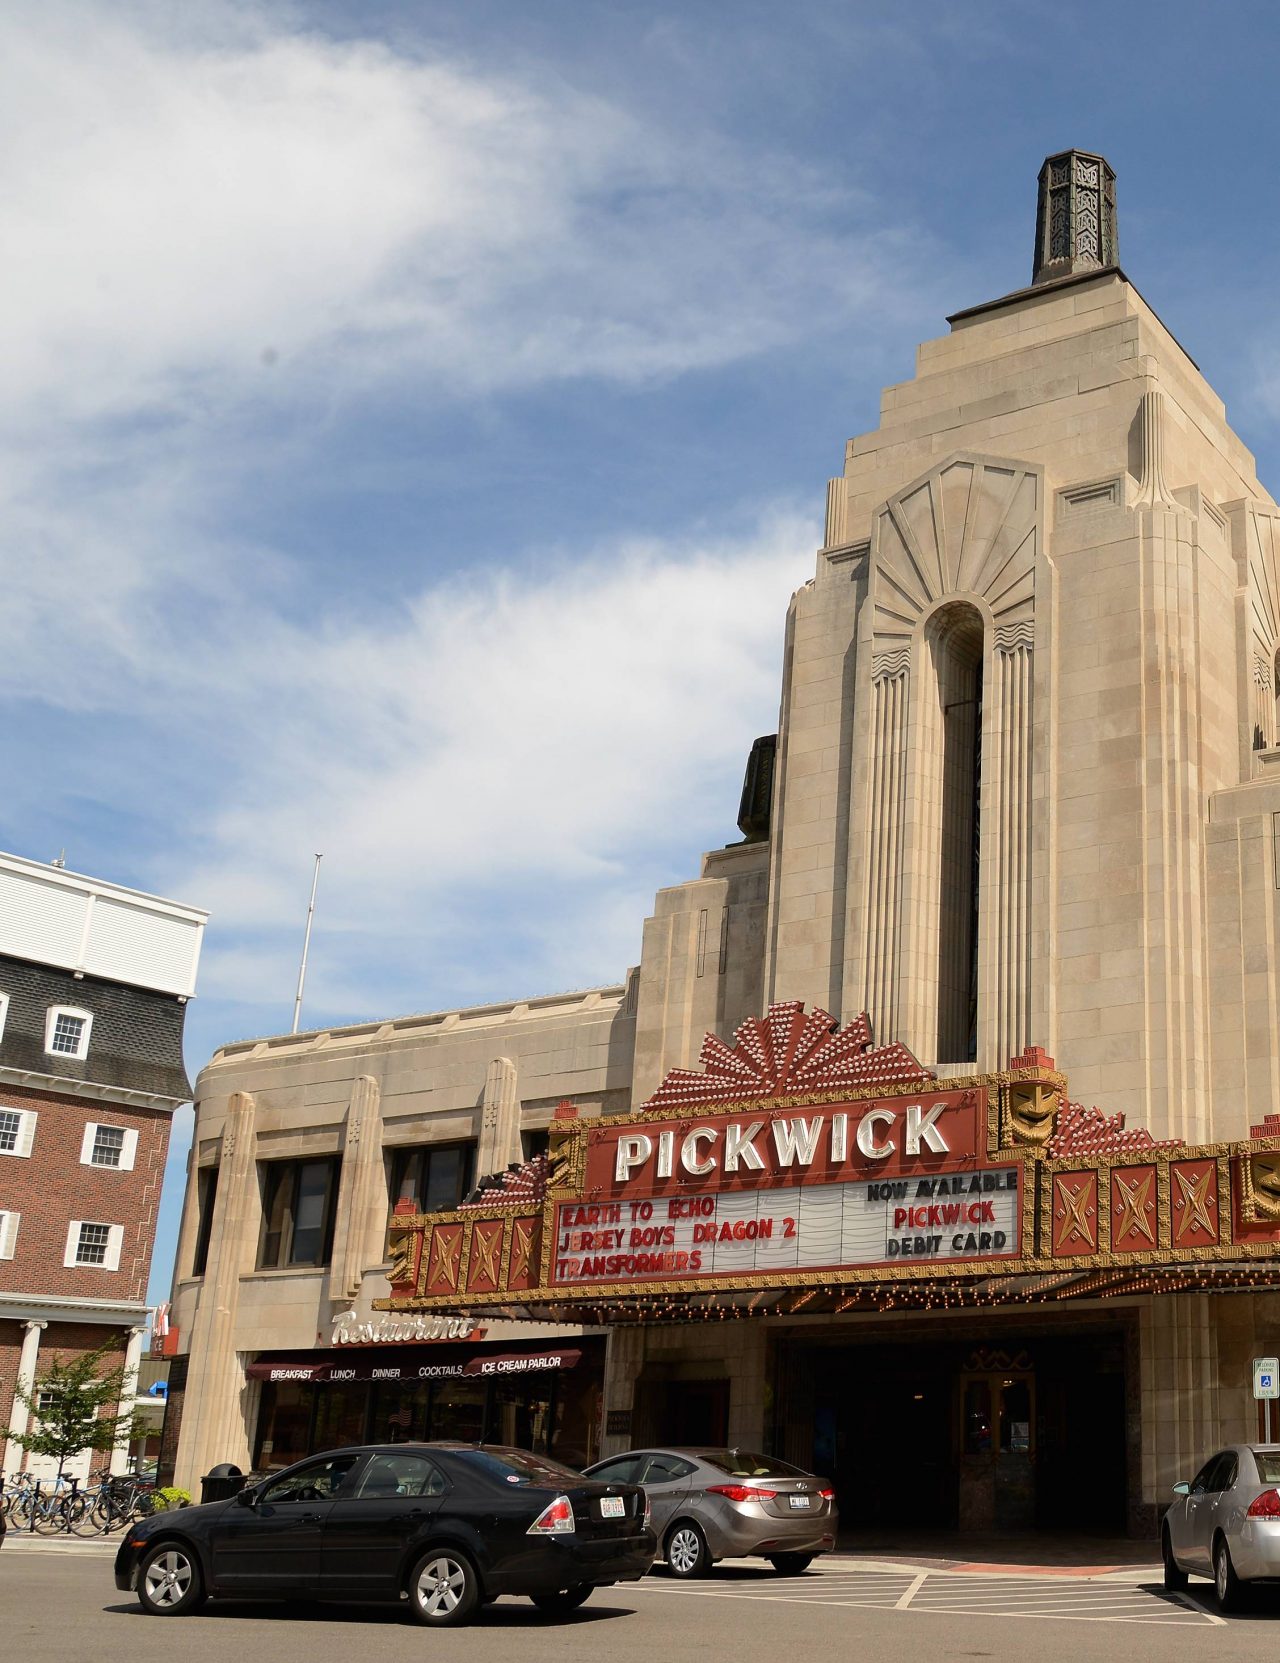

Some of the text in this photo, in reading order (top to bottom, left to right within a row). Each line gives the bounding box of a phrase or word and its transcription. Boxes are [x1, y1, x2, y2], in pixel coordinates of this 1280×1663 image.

[615, 1102, 950, 1182] PICKWICK
[868, 1171, 1018, 1202] NOW AVAILABLE
[562, 1196, 715, 1227] EARTH TO ECHO
[894, 1200, 996, 1229] PICKWICK
[559, 1216, 797, 1252] JERSEY BOYS DRAGON 2
[888, 1230, 1007, 1257] DEBIT CARD
[557, 1250, 702, 1278] TRANSFORMERS
[331, 1310, 474, 1344] Restaurant
[270, 1369, 314, 1379] BREAKFAST
[330, 1369, 356, 1379] LUNCH
[372, 1368, 401, 1378] DINNER
[418, 1365, 463, 1377] COCKTAILS
[481, 1356, 562, 1373] ICE CREAM PARLOR
